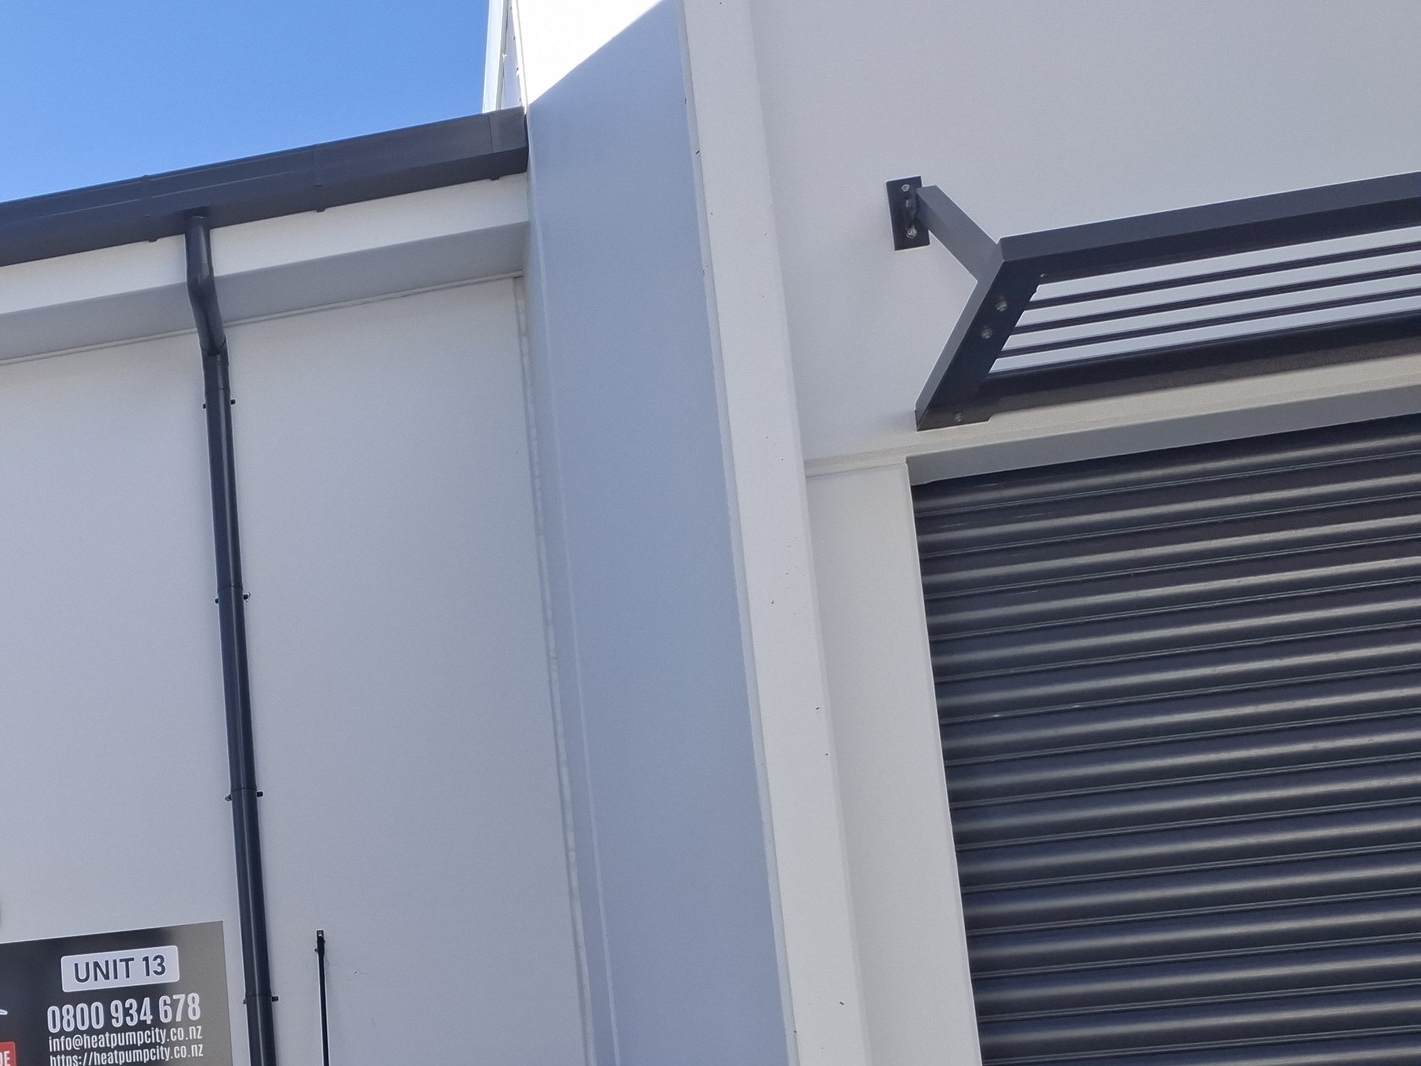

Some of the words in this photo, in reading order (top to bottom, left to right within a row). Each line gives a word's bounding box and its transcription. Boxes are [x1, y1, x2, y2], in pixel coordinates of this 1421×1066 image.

[74, 957, 134, 983] UNIT
[142, 954, 166, 977] 13
[47, 1001, 105, 1034] 0800
[110, 997, 153, 1028] 934
[158, 992, 201, 1024] 678
[48, 1025, 203, 1052] info@heatpumpcity.co.nz
